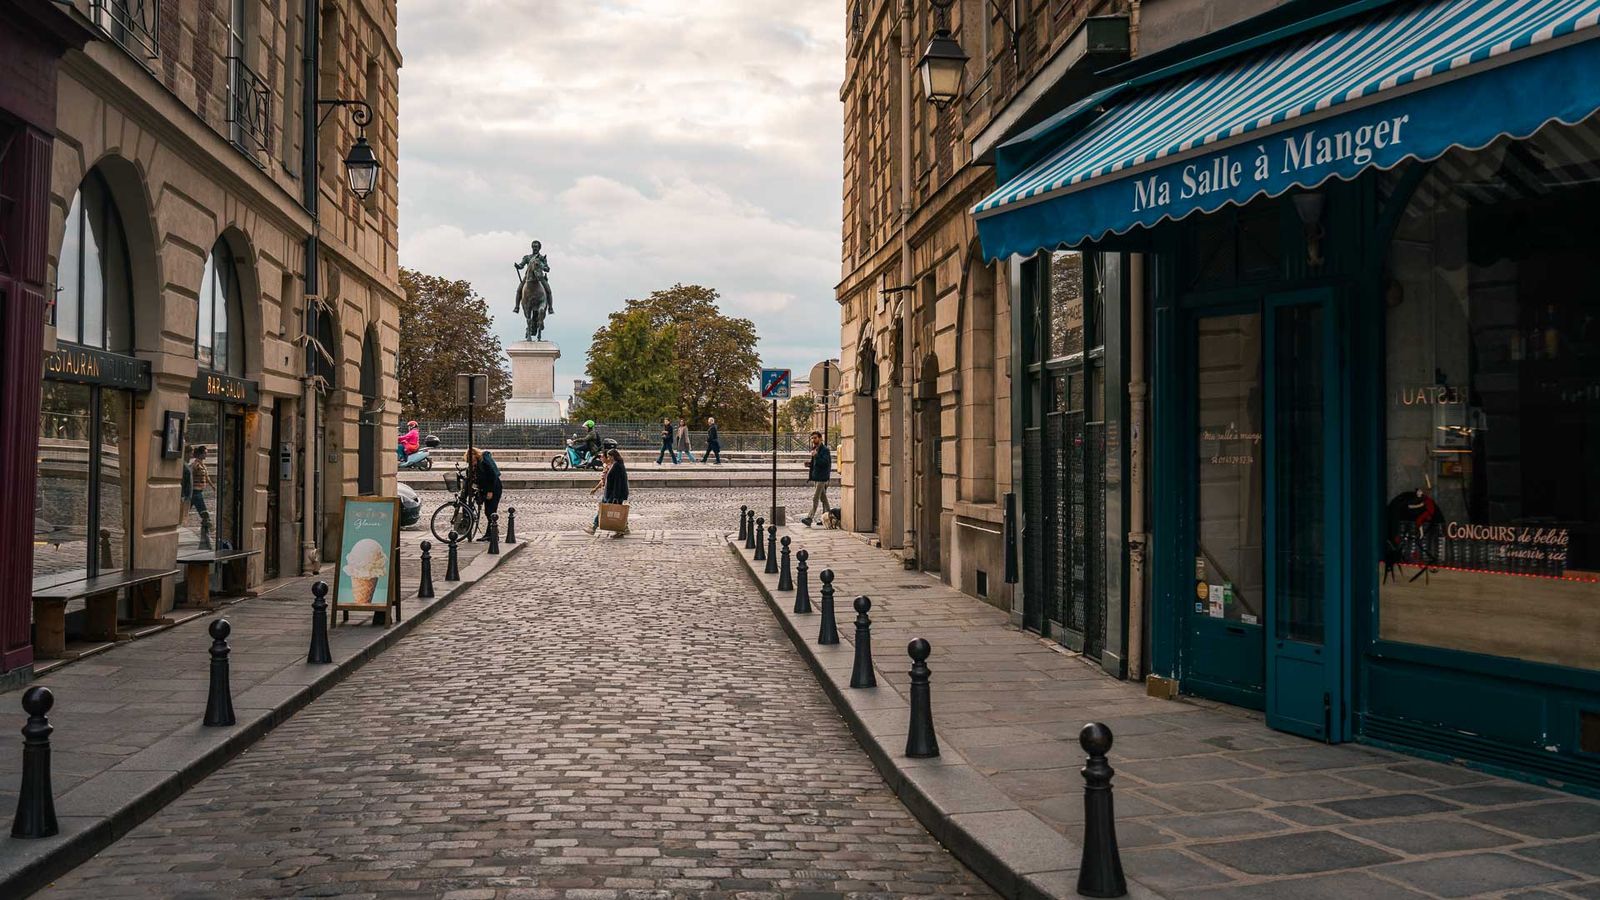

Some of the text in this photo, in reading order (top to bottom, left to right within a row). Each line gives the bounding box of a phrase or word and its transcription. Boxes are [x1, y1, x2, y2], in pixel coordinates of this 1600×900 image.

[1131, 114, 1410, 213] Ma Salle à Manger
[1517, 527, 1532, 544] de
